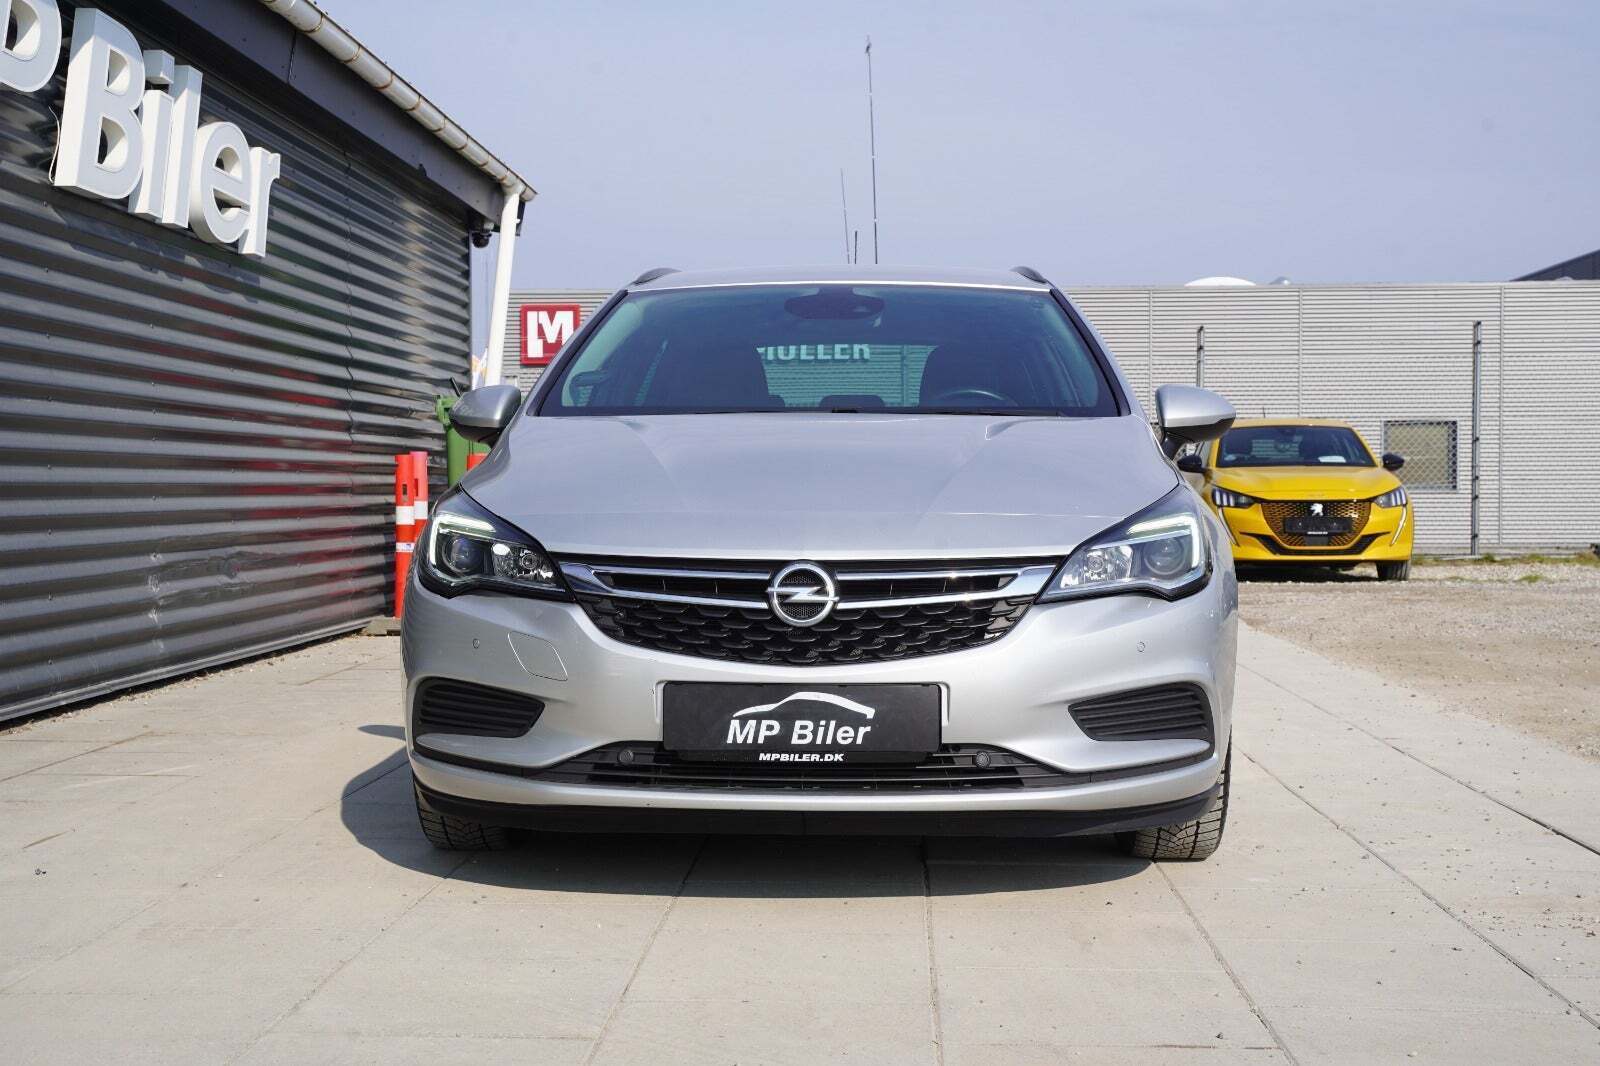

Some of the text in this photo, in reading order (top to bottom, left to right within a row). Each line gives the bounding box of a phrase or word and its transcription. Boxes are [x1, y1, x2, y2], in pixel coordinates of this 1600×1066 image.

[54, 7, 280, 257] Biler
[727, 719, 871, 745] MP Biler
[758, 752, 844, 762] MPBILER.DK
